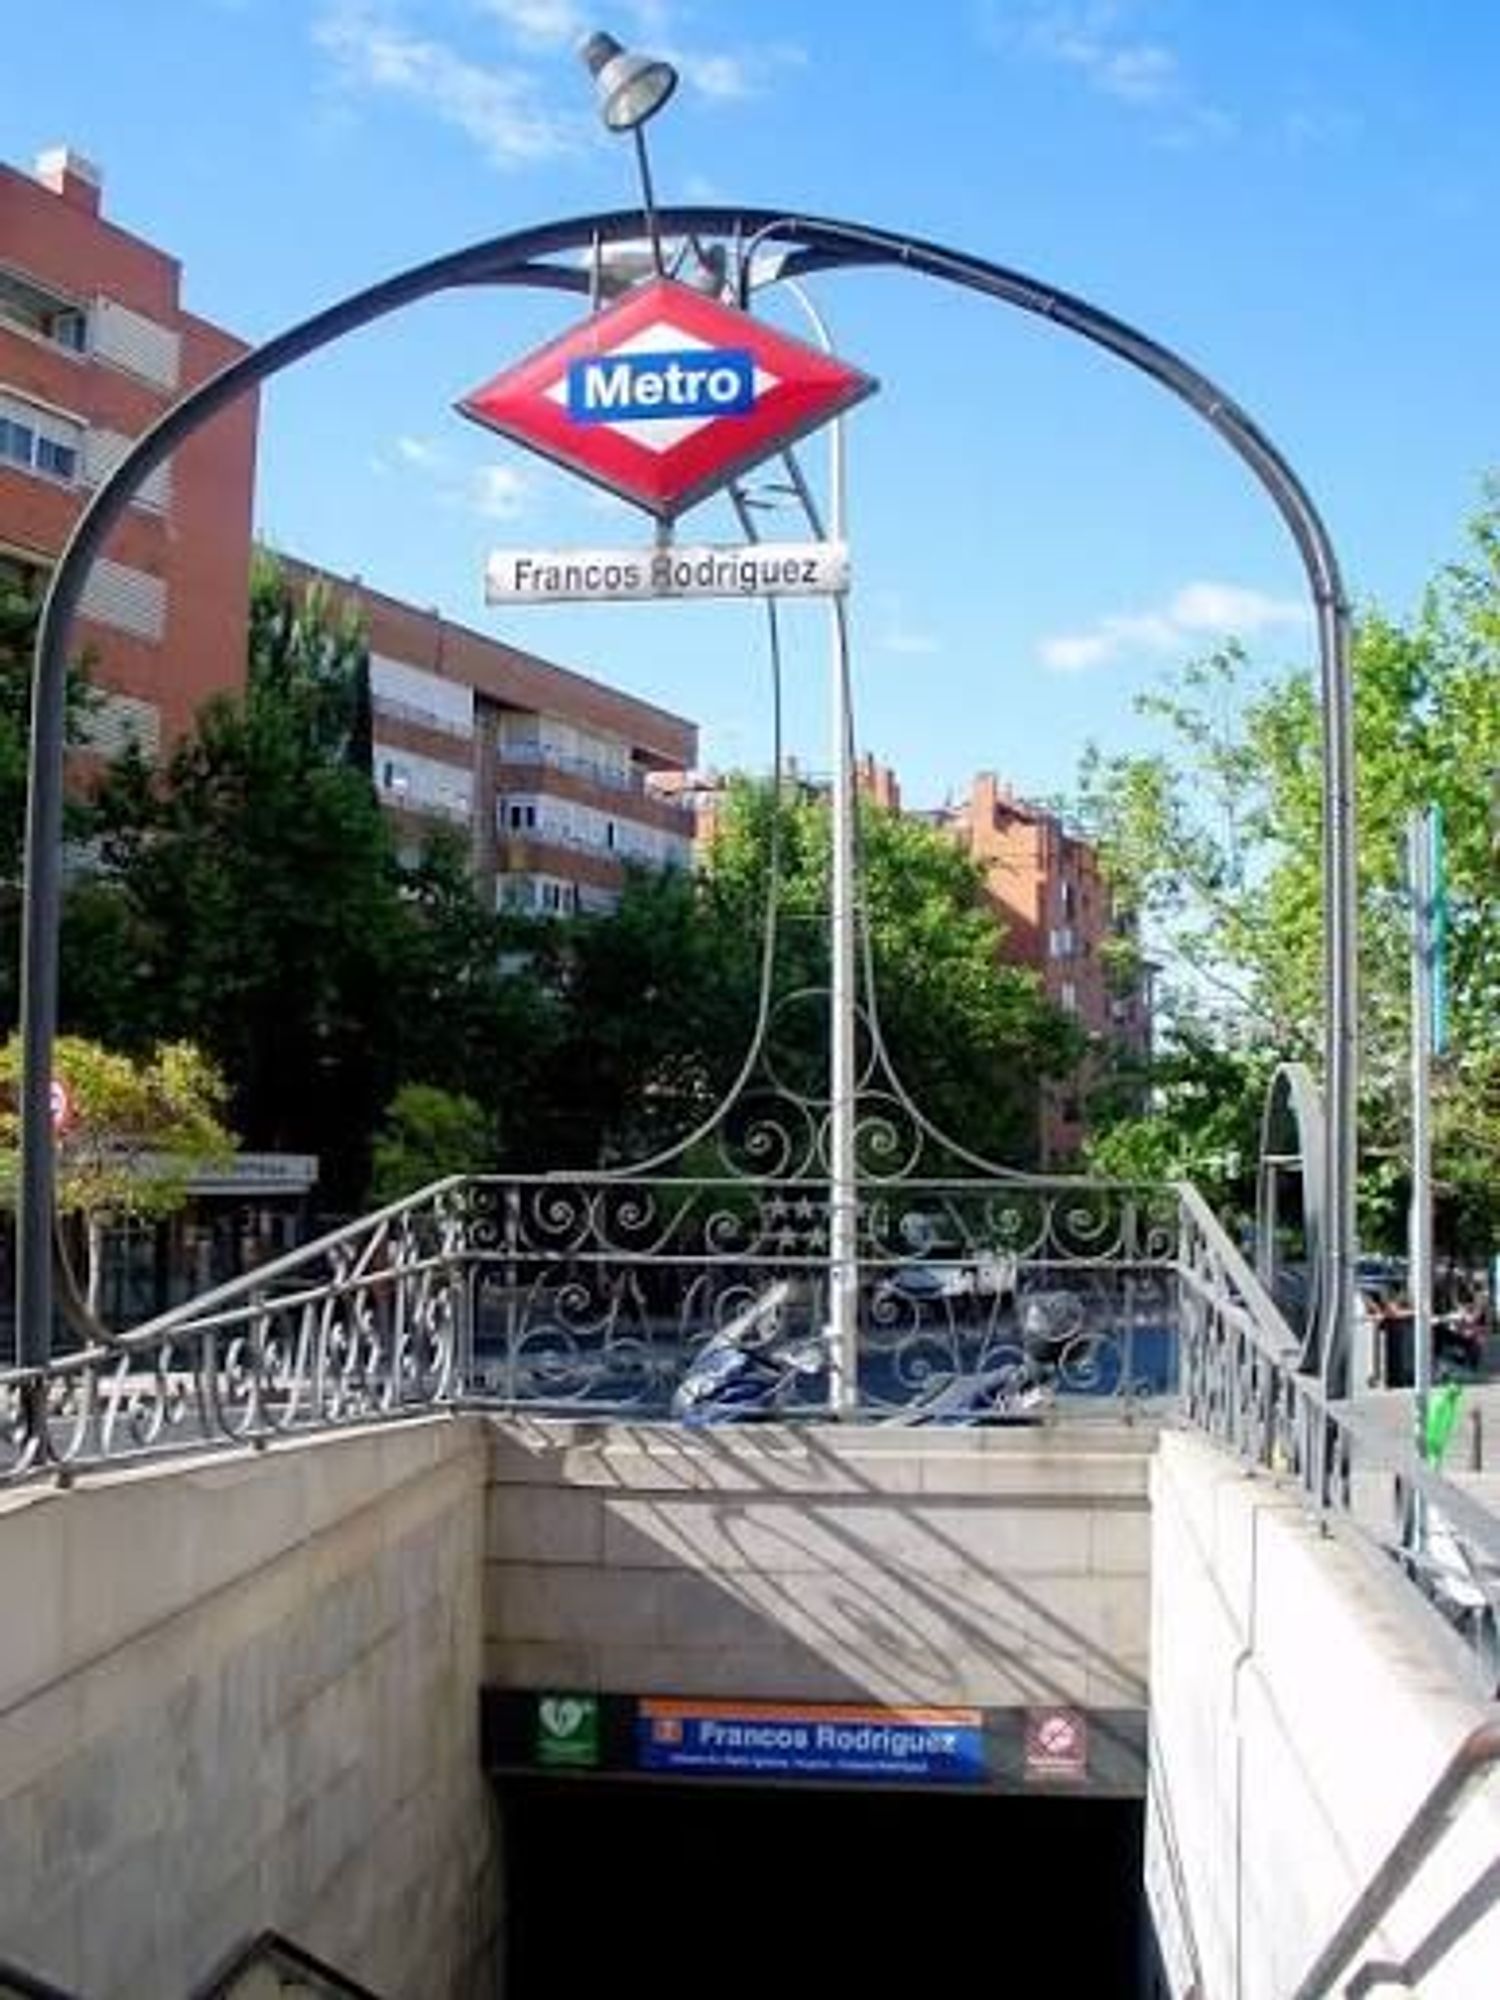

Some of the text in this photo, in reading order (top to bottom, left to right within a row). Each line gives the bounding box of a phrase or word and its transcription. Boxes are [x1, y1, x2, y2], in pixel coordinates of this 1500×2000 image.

[585, 361, 741, 408] Metro
[515, 558, 641, 591] Francos
[699, 1719, 809, 1749] Francos
